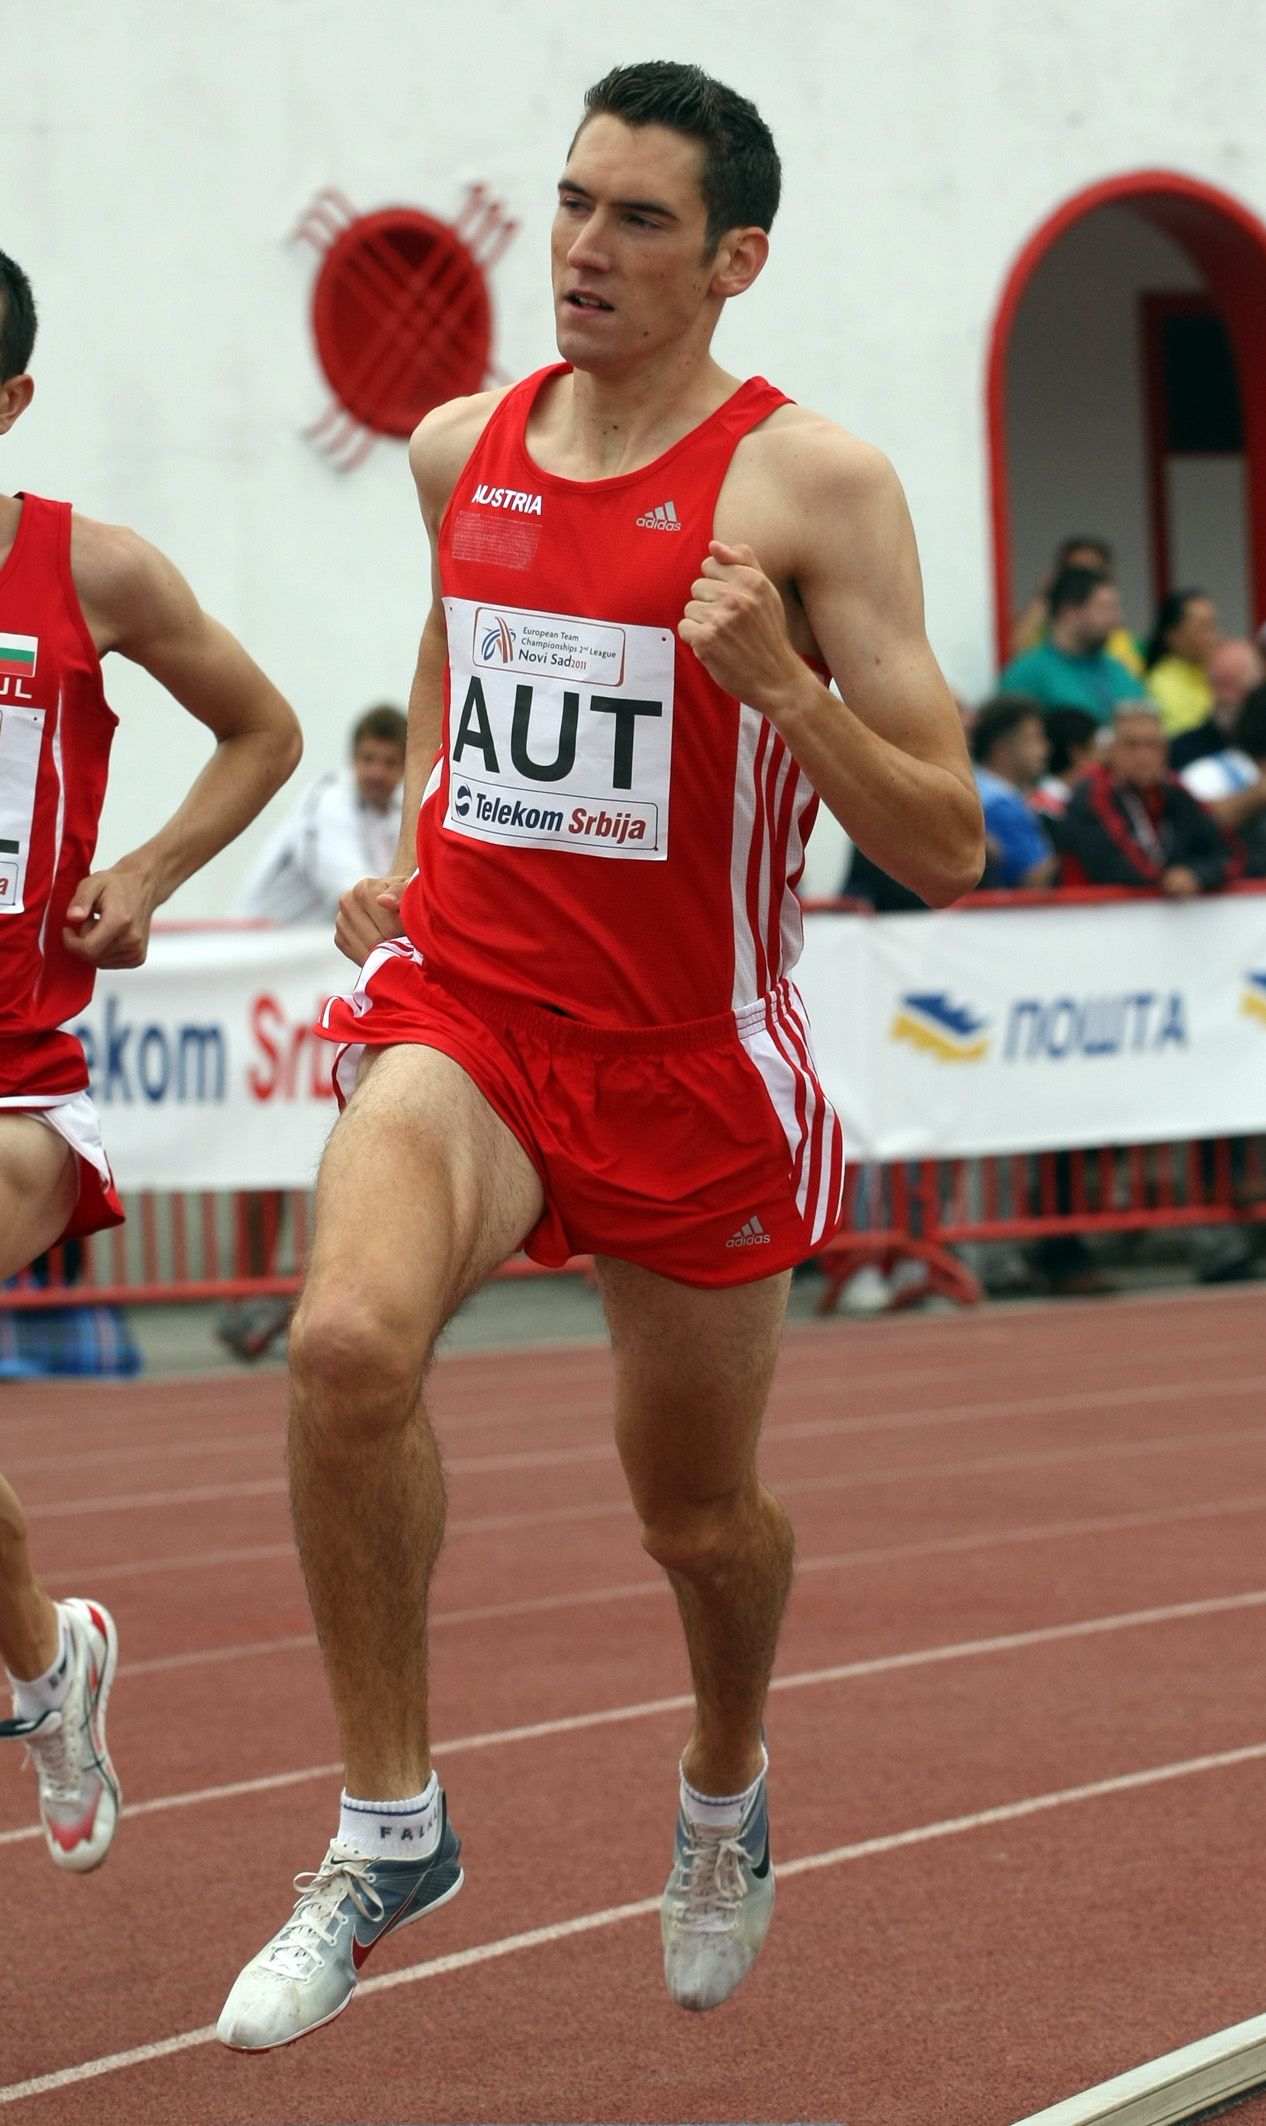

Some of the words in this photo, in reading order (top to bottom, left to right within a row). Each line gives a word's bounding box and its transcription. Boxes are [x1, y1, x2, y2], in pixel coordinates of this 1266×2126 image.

[471, 484, 543, 516] AUSTRIA
[636, 517, 682, 532] adidas
[522, 626, 559, 640] European
[560, 631, 579, 642] Team
[518, 649, 548, 664] Novi
[521, 637, 578, 653] Championships
[589, 648, 617, 659] League
[452, 675, 663, 790] AUT
[476, 793, 564, 832] Telekom
[568, 808, 647, 844] Srbija
[1003, 990, 1189, 1062] ПОШТА
[725, 1234, 771, 1248] adidas
